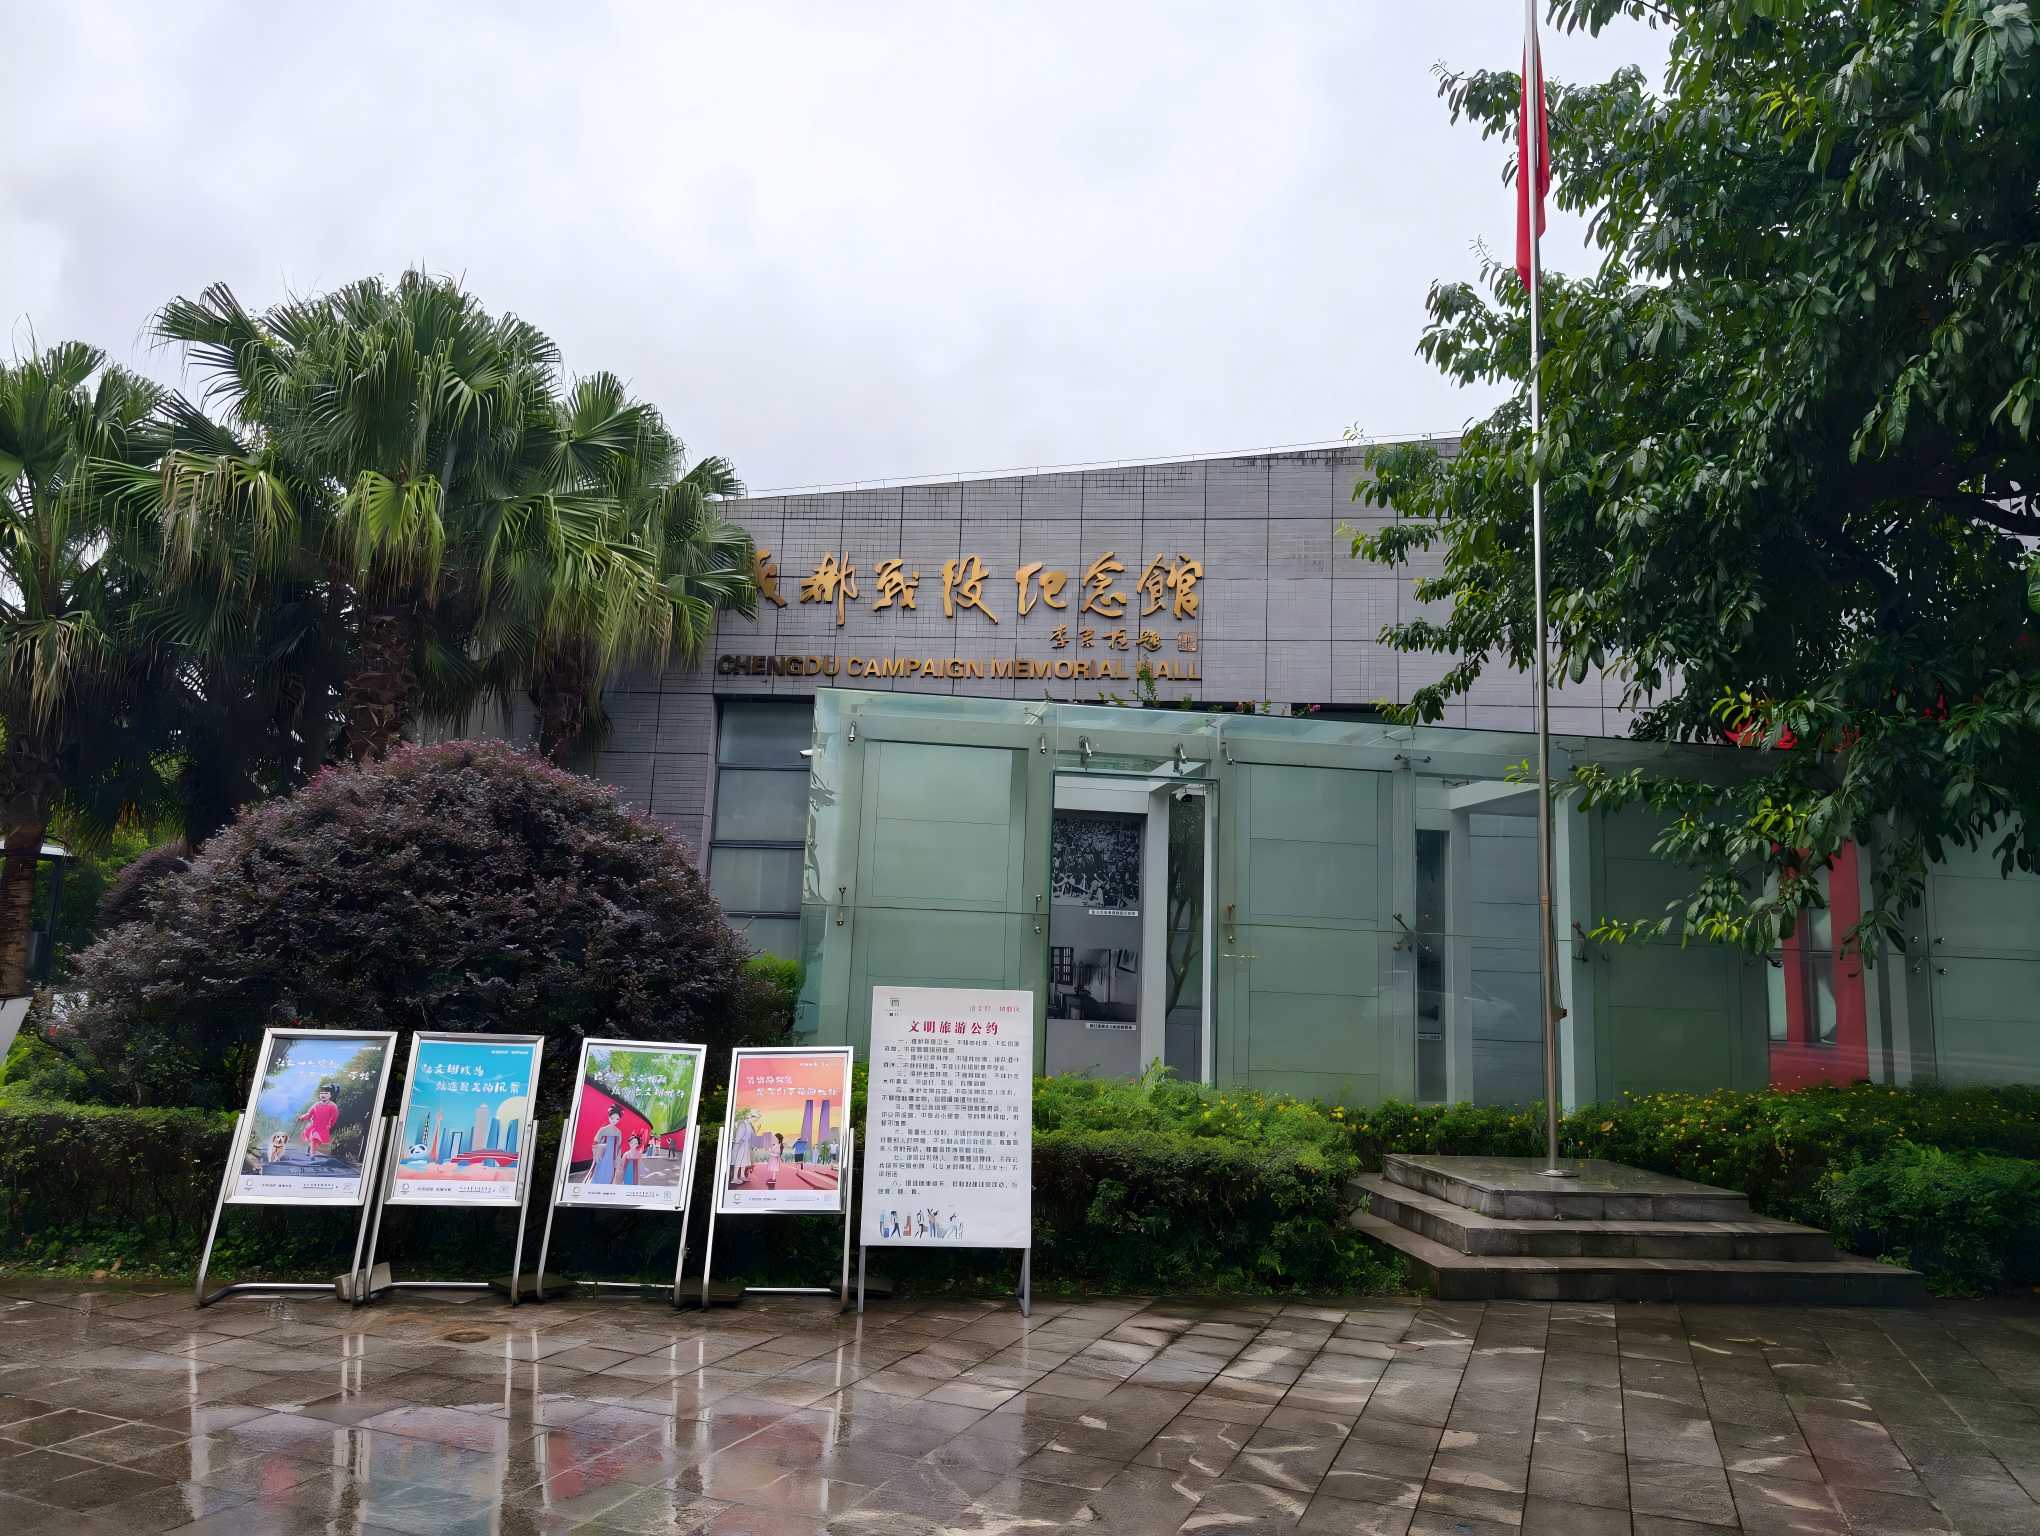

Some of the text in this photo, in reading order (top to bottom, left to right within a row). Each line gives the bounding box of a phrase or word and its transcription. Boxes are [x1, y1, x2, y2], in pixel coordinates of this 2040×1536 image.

[717, 654, 841, 677] CHENGDU
[847, 655, 985, 679] CAMPAIGN
[991, 657, 1129, 680] MEMORIAL
[908, 1020, 998, 1035] 文明旅游公约
